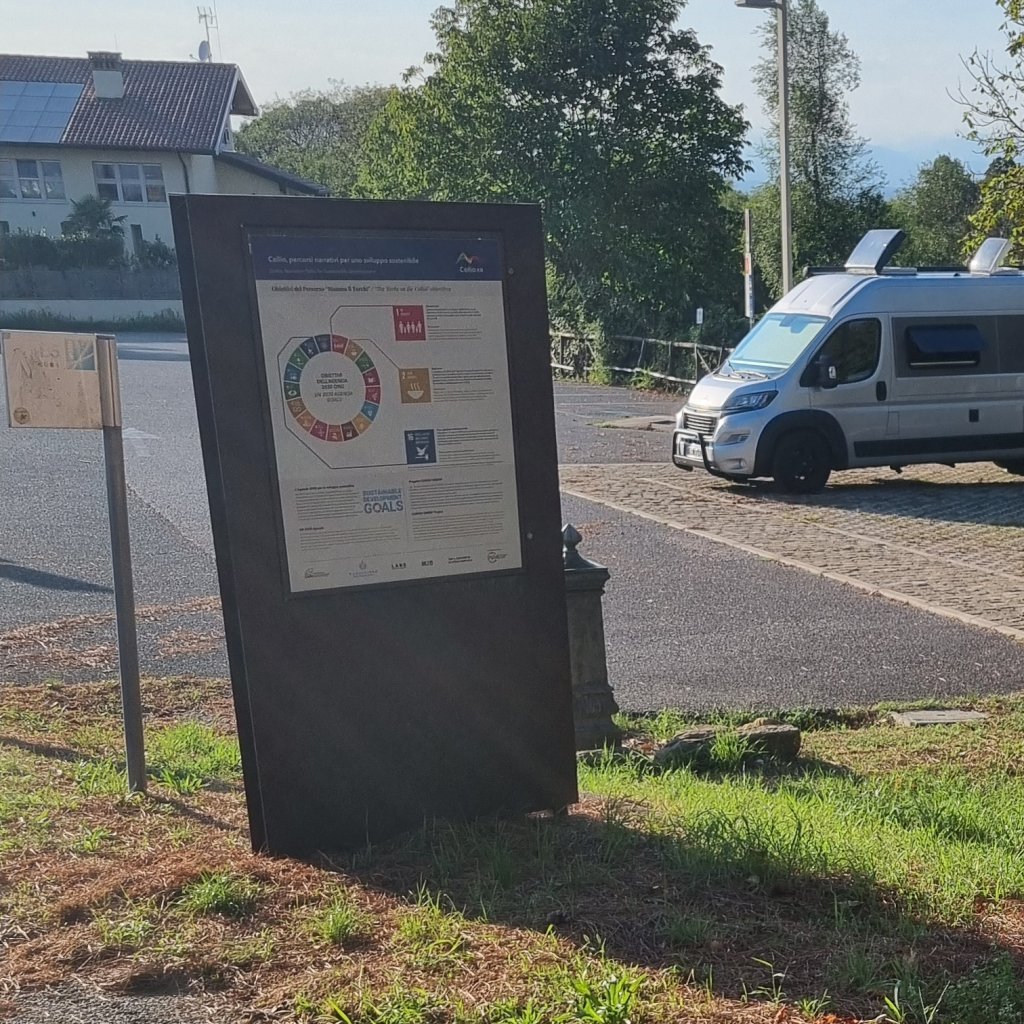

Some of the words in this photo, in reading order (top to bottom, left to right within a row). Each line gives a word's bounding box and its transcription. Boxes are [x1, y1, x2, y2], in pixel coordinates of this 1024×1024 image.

[289, 256, 312, 265] percorsi
[340, 258, 350, 266] per
[364, 257, 388, 266] sviluppo
[364, 501, 404, 514] GOALS
